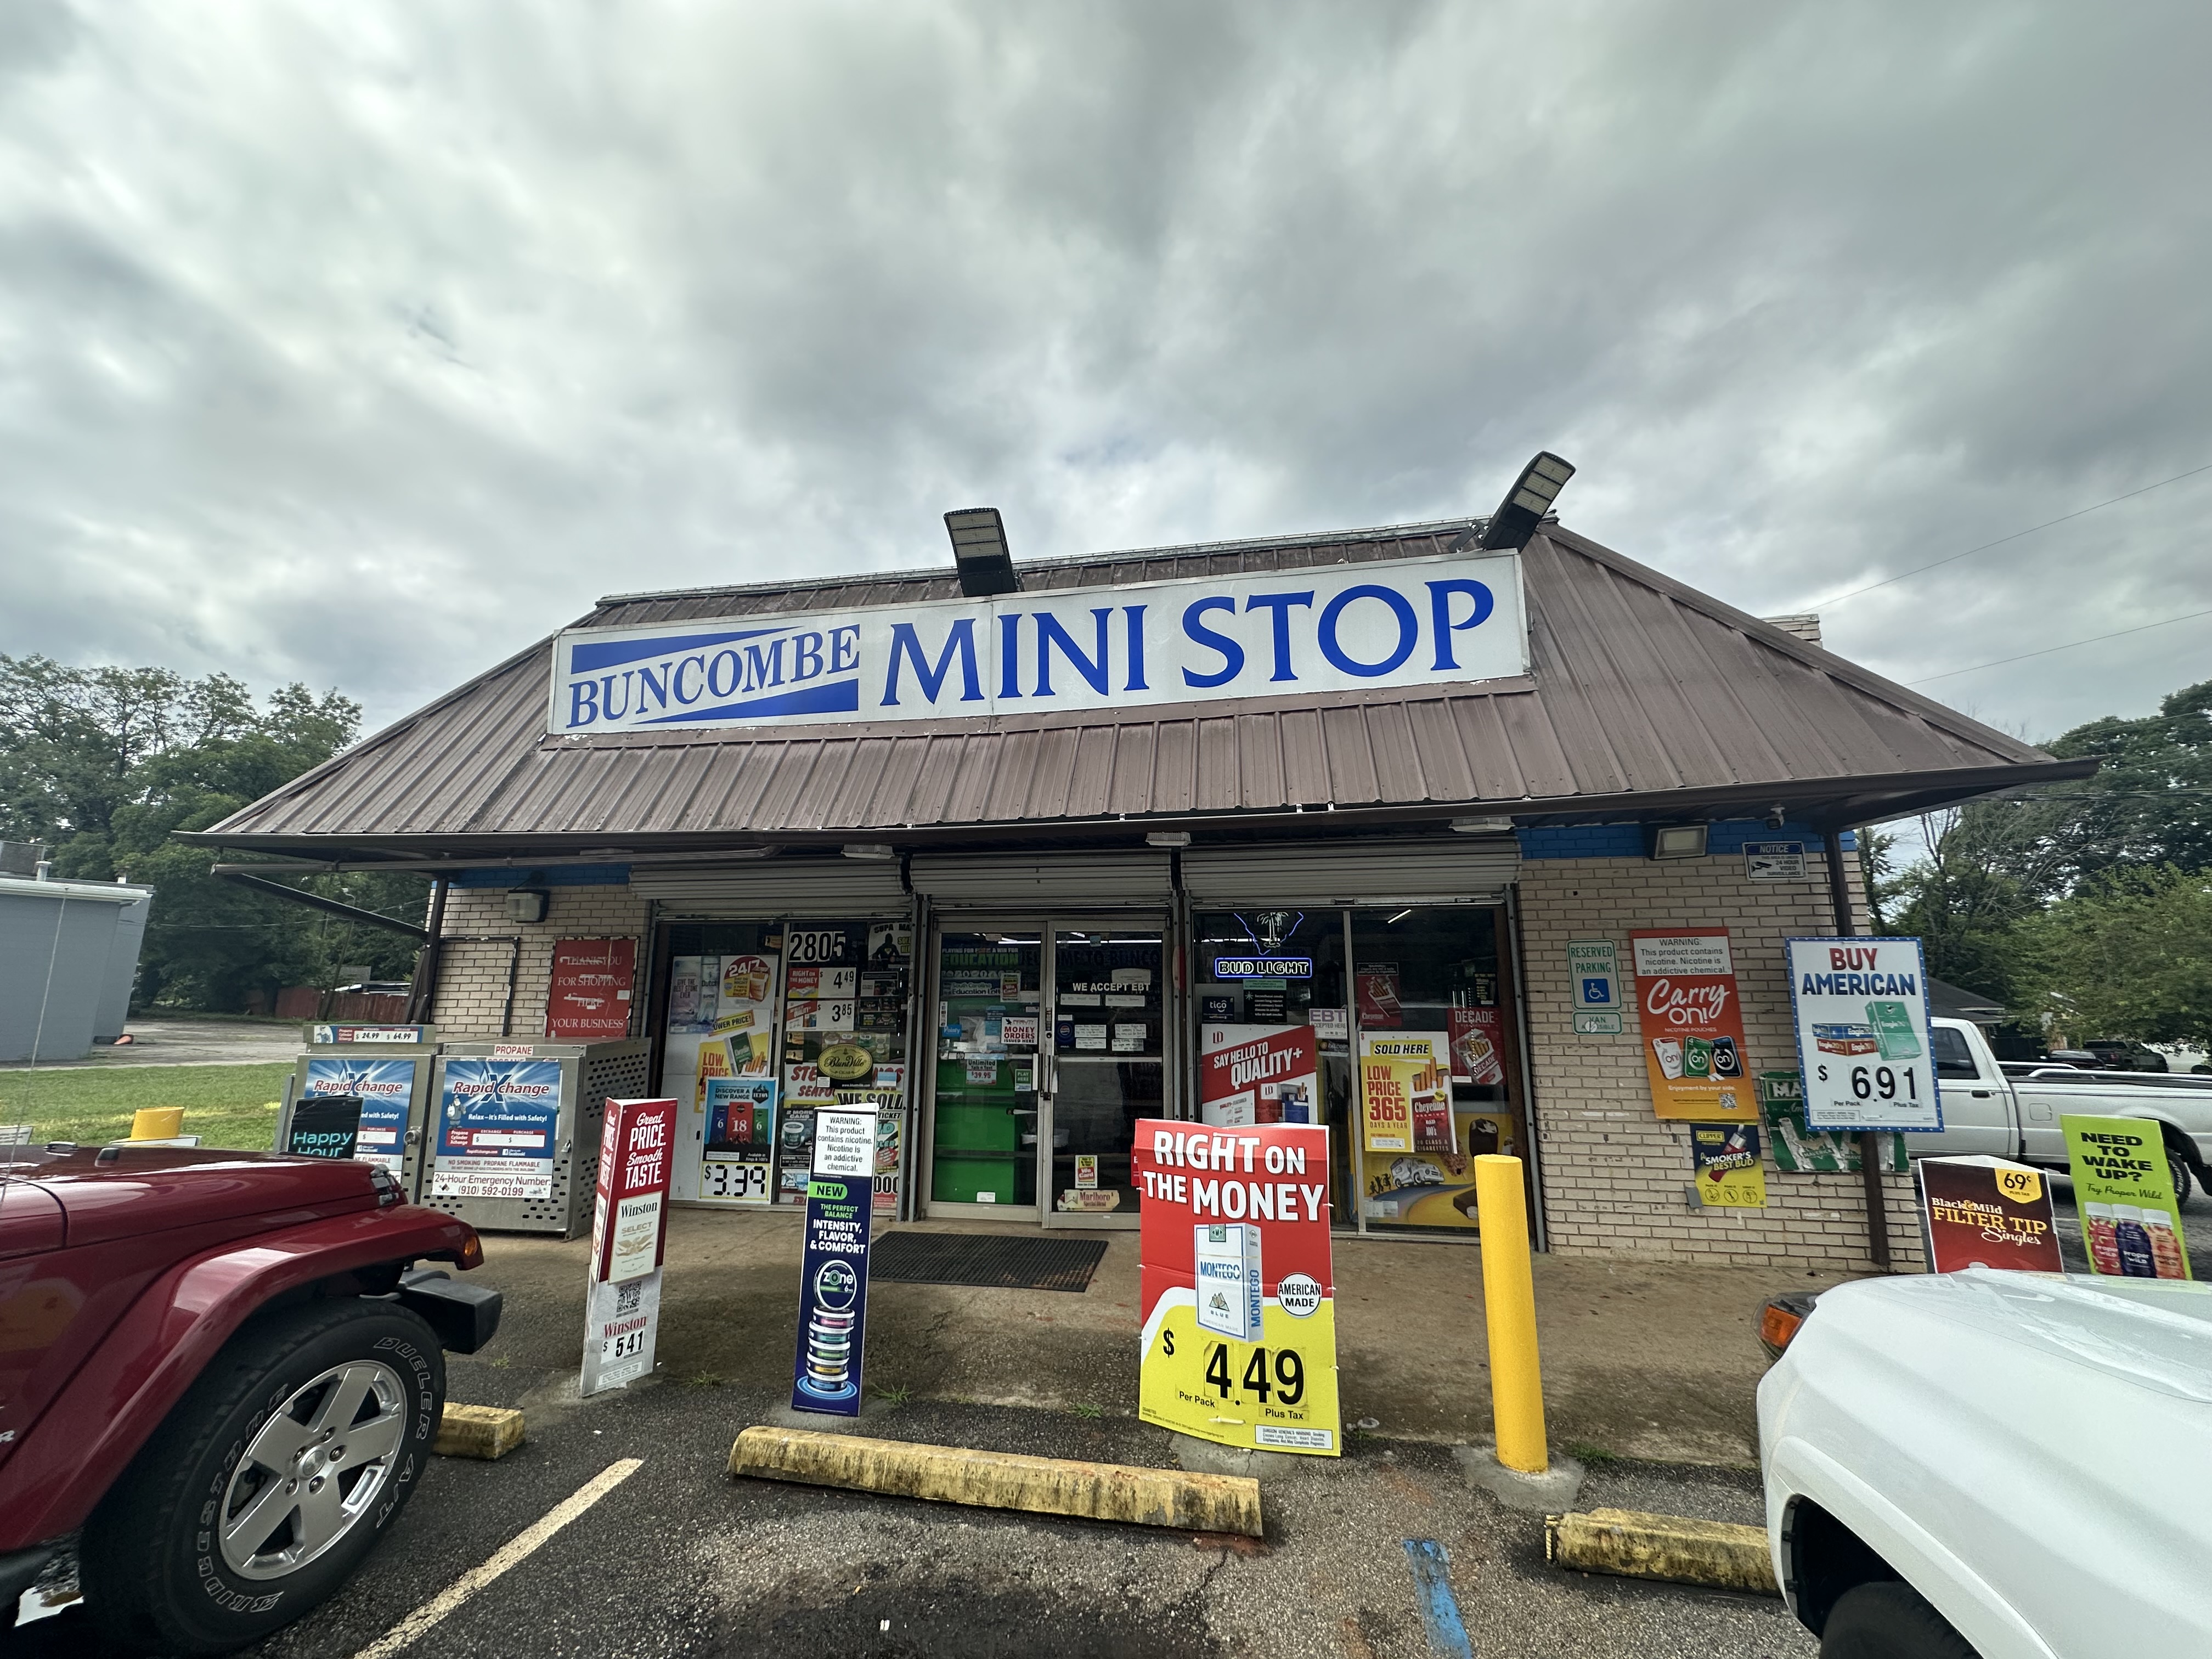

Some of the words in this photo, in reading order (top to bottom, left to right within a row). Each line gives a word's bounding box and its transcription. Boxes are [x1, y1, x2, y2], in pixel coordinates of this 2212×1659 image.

[566, 622, 860, 729] BUNCOMBE
[881, 605, 1150, 707] MINI
[1181, 578, 1494, 688] STOP
[874, 924, 894, 933] SUPA
[789, 933, 845, 961] 2805
[1571, 946, 1612, 958] RESERVED
[1659, 949, 1688, 957] product
[603, 957, 622, 965] YOU
[942, 953, 1018, 966] EDUCATION
[1829, 948, 1878, 970] BUY
[729, 959, 760, 977] 24/7
[1218, 961, 1254, 974] BUD
[1257, 961, 1309, 974] LIGHT
[1576, 962, 1611, 973] PARKING
[558, 977, 576, 986] FOR
[578, 977, 626, 986] SHOPPING
[1091, 983, 1128, 991] ACCEPT
[1131, 983, 1150, 991] EBT
[1802, 973, 1916, 995] AMERICAN
[1647, 978, 1730, 1019] Carry
[732, 1015, 751, 1025] PRICE!
[1310, 1009, 1346, 1023] EBT
[1455, 1011, 1495, 1023] DECADE
[552, 1018, 578, 1028] YOUR
[581, 1019, 624, 1028] BUSINESS
[495, 1046, 533, 1055] PROPANE
[1214, 1053, 1229, 1069] SAY
[1230, 1045, 1255, 1063] HELLO
[1257, 1041, 1268, 1056] TO
[1374, 1045, 1400, 1054] SOLD
[1403, 1045, 1429, 1054] HERE
[703, 1052, 724, 1066] LOW
[824, 1056, 865, 1067] BluntVille
[1231, 1047, 1302, 1090] QUALITY+
[1367, 1065, 1391, 1080] LOW
[1367, 1081, 1401, 1096] PRICE
[1818, 1064, 1828, 1082] $
[1852, 1066, 1916, 1102] 6.91
[1369, 1097, 1406, 1121] 365
[1415, 1101, 1445, 1113] Cheyenne
[636, 1111, 664, 1126] Great
[830, 1116, 862, 1125] WARNING:
[732, 1119, 747, 1132] 18
[840, 1127, 865, 1135] product
[292, 1132, 353, 1146] Happy
[629, 1124, 666, 1151] PRICE.
[817, 1135, 843, 1143] contains
[845, 1136, 872, 1144] nicotine.
[2080, 1132, 2143, 1146] NEED
[827, 1144, 853, 1153] Nicotine
[1154, 1130, 1260, 1173] RIGHT
[1265, 1146, 1305, 1175] ON
[2097, 1146, 2130, 1156] TO
[627, 1148, 663, 1166] Smooth
[833, 1155, 862, 1163] addictive
[1706, 1152, 1751, 1165] SMOKER'S
[2081, 1155, 2154, 1171] WAKE
[827, 1163, 858, 1172] chemical.
[1713, 1162, 1733, 1171] BEST
[1735, 1159, 1754, 1167] BUD
[435, 1174, 467, 1184] 24-Hour
[469, 1175, 514, 1186] Emergency
[516, 1176, 551, 1186] Number:
[625, 1161, 663, 1190] TASTE.
[704, 1165, 712, 1181] $
[713, 1164, 766, 1197] 3.39
[2096, 1169, 2143, 1182] UP?
[458, 1186, 479, 1195] (910)
[482, 1186, 523, 1196] 592-0199
[816, 1185, 844, 1197] NEW
[1080, 1192, 1110, 1200] Marlboro
[1142, 1170, 1187, 1204] THE
[1192, 1177, 1324, 1221] MONEY
[2086, 1183, 2102, 1195] Try
[2105, 1186, 2136, 1197] Proper
[2140, 1189, 2163, 1199] Wild
[621, 1202, 657, 1218] Winston
[832, 1204, 859, 1212] PERFECT
[813, 1219, 862, 1234] INTENSITY,
[1933, 1206, 2007, 1229] FILTER
[2009, 1216, 2047, 1235] TIP
[622, 1221, 653, 1234] SELECT
[819, 1230, 857, 1243] FLAVOR,
[1981, 1226, 2041, 1246] Singles
[810, 1240, 817, 1250] &
[818, 1241, 865, 1254] COMFORT
[1200, 1261, 1241, 1280] MONTEGO
[1278, 1283, 1321, 1296] AMERICAN
[1248, 1269, 1260, 1329] MONTEGO
[1285, 1298, 1314, 1307] MADE
[1211, 1310, 1229, 1319] BLUE
[604, 1316, 647, 1338] Winston
[603, 1341, 608, 1352] $
[1163, 1328, 1174, 1358] $
[1205, 1342, 1305, 1406] 4.49
[374, 1336, 433, 1440] DUELER
[1179, 1390, 1193, 1400] Per
[1194, 1394, 1215, 1408] Pack
[1265, 1408, 1285, 1418] Plus
[1288, 1410, 1304, 1420] Tax
